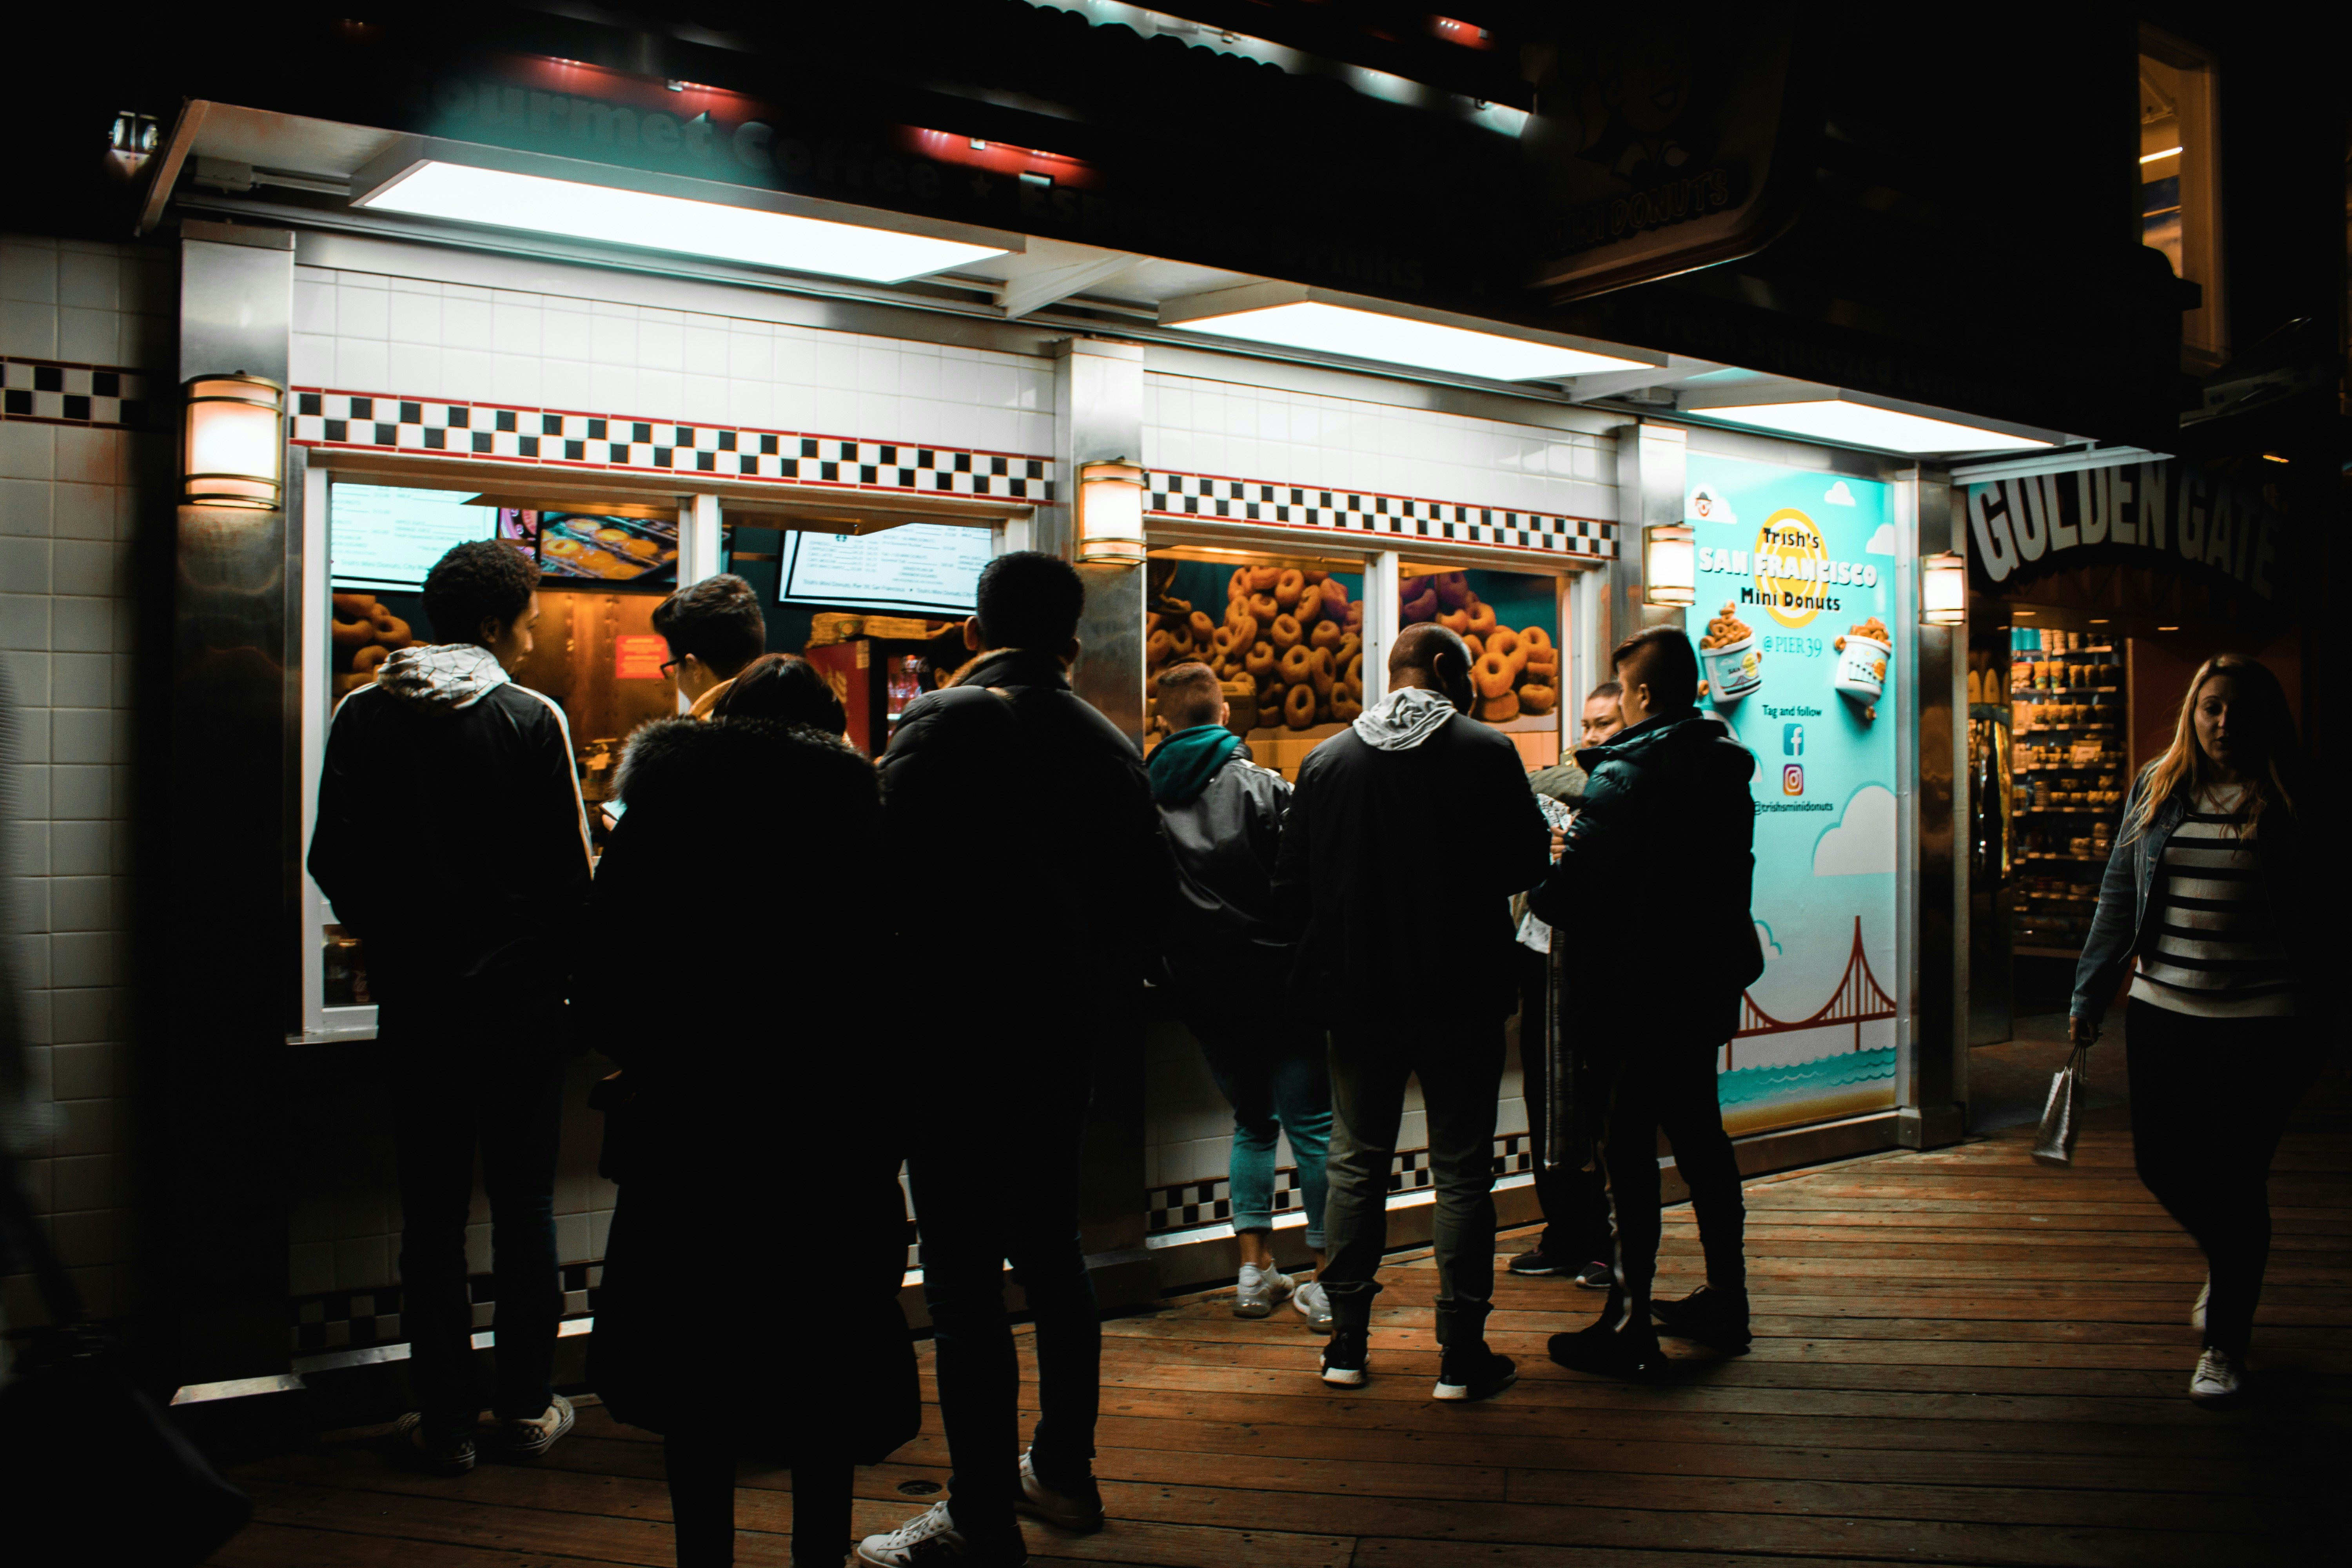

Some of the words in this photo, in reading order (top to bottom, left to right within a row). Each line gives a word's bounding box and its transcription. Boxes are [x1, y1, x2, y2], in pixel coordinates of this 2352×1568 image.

[734, 120, 941, 200] Coffee
[1612, 169, 1729, 236] DONUTS
[1763, 527, 1820, 549] Trish's
[1968, 460, 2167, 583] GOLDEN
[2178, 465, 2283, 601] GATE
[1699, 547, 1749, 576] SAN
[1754, 553, 1878, 588] FRANCISCO
[1741, 588, 1777, 607] Mini
[1784, 590, 1841, 612] Donuts
[1776, 636, 1804, 653] PIER
[1805, 637, 1823, 658] 39
[1762, 704, 1777, 719] Tag
[1779, 706, 1795, 716] and
[1797, 706, 1822, 717] follow
